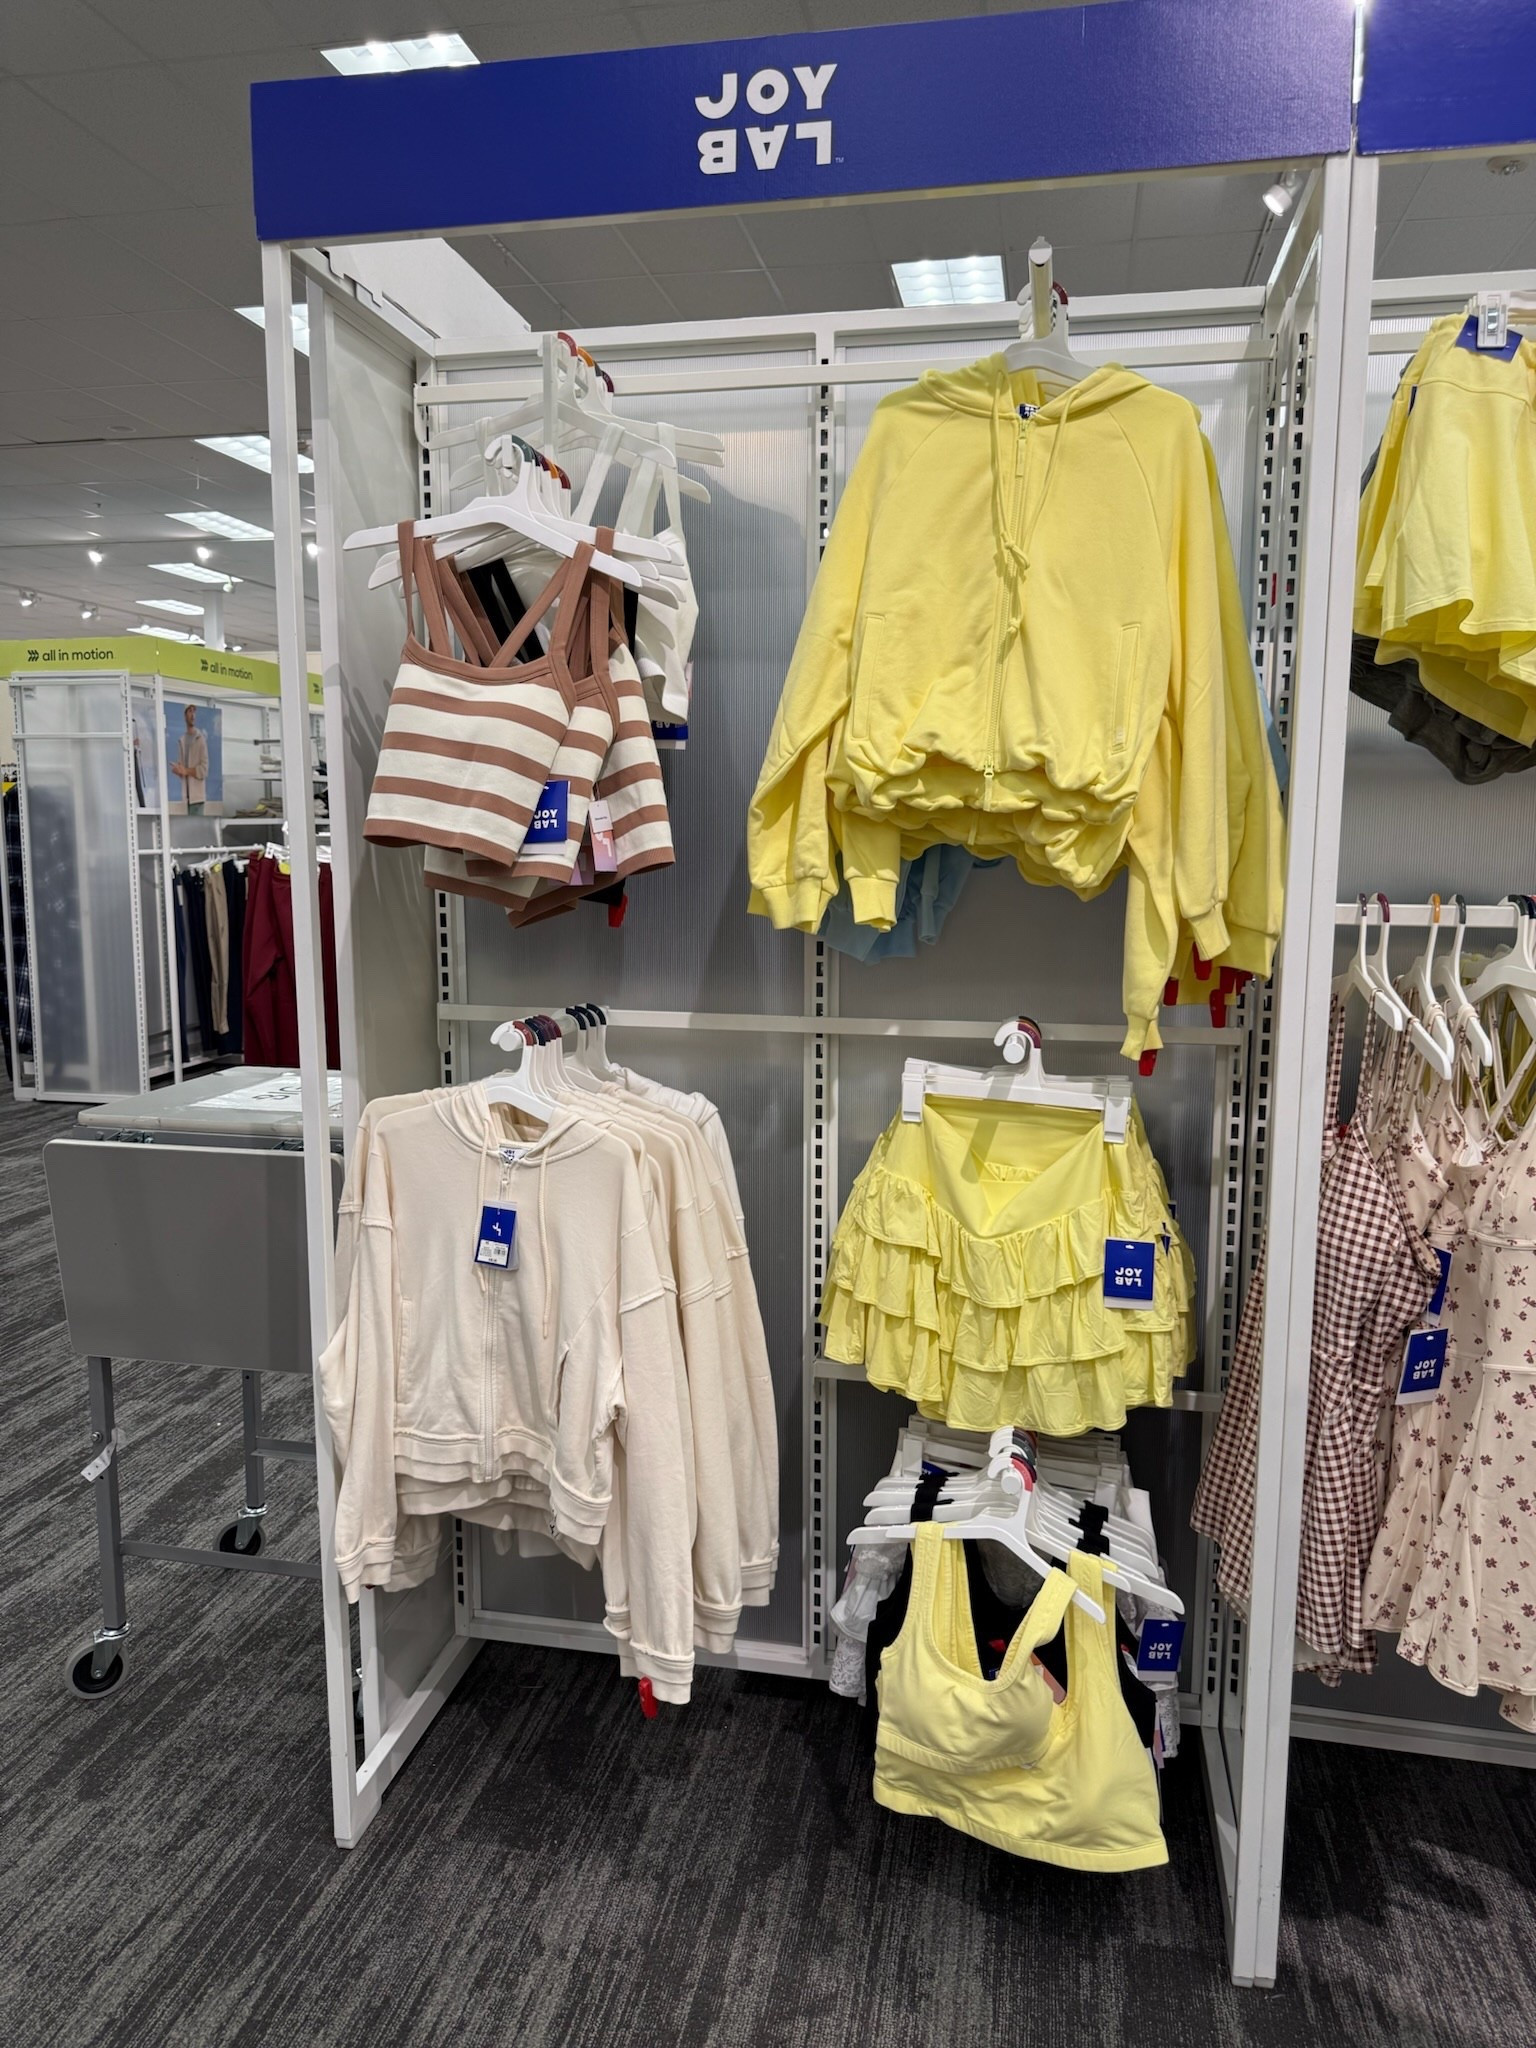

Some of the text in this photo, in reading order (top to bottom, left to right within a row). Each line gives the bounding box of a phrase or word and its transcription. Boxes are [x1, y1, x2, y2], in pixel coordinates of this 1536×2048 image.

[695, 64, 838, 119] JOY
[697, 120, 832, 175] LAB
[42, 647, 114, 661] all in motion
[210, 662, 253, 680] all in motion
[534, 809, 558, 819] JOY
[534, 819, 558, 829] LAB
[1114, 1267, 1142, 1277] JOY
[1115, 1276, 1142, 1287] LAB
[1414, 1358, 1436, 1370] JOY
[1412, 1369, 1435, 1380] LAB
[1149, 1643, 1173, 1651] JOY
[1148, 1651, 1171, 1660] LAB
